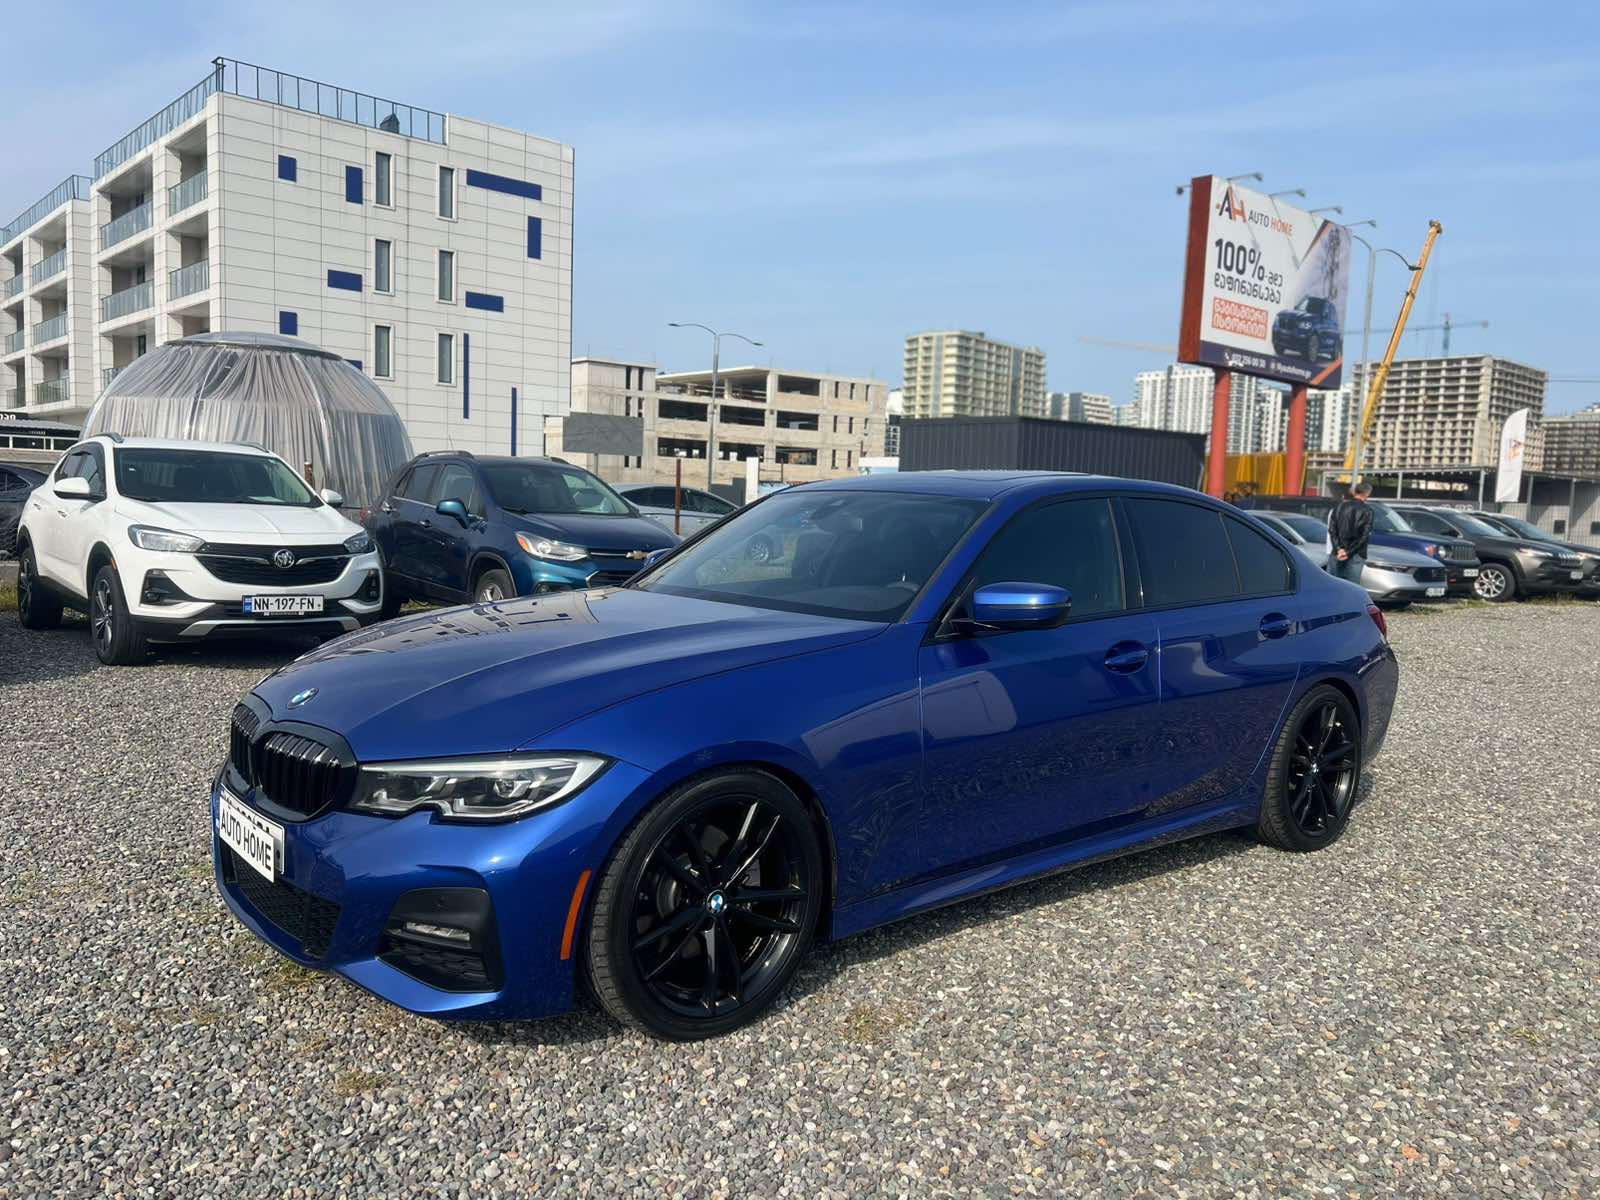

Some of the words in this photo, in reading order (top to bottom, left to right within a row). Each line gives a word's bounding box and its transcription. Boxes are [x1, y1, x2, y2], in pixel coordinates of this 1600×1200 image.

[1248, 209, 1270, 228] AUTO
[1271, 217, 1293, 236] HOME
[253, 597, 315, 610] NN-197-FN
[221, 808, 241, 845] AUTO
[243, 826, 272, 872] HOME
